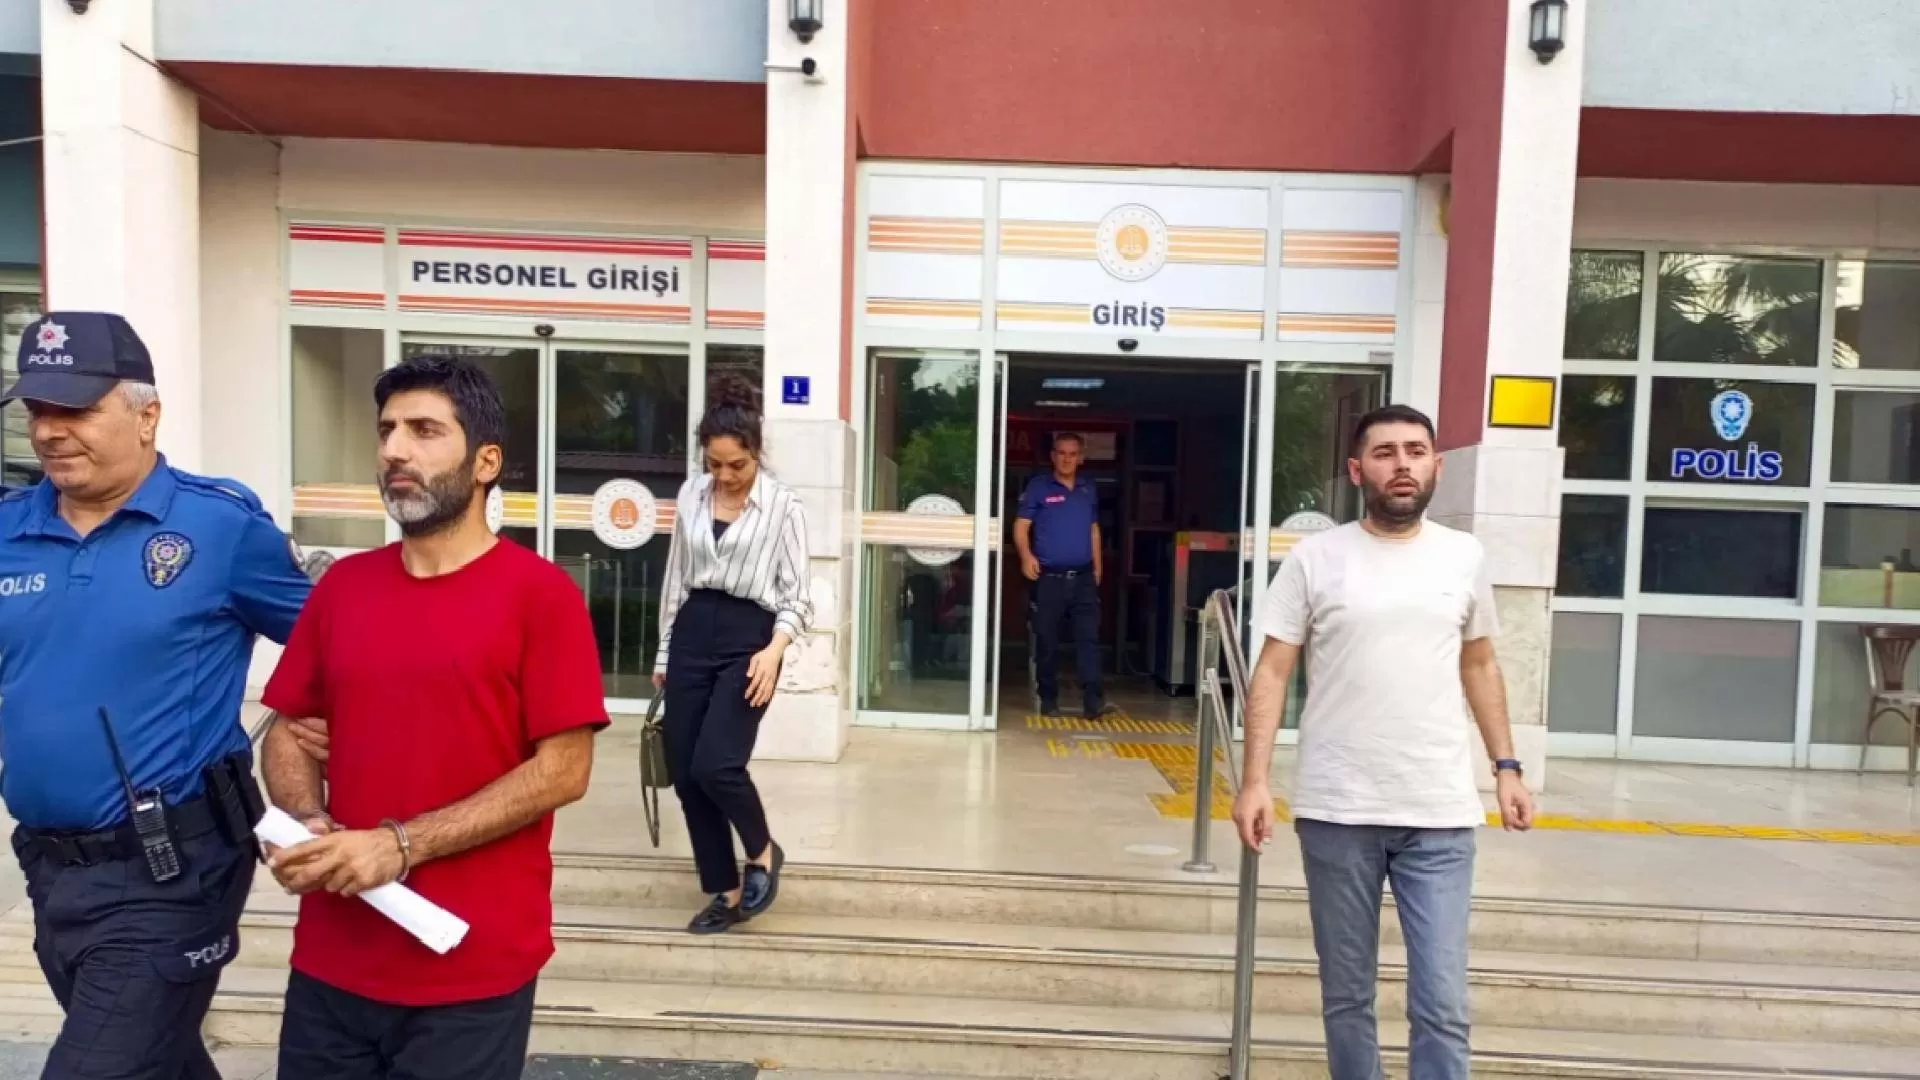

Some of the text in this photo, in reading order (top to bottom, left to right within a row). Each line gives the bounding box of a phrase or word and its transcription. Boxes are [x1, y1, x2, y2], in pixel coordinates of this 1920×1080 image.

[412, 260, 679, 297] PERSONEL GİRİŞİ
[1092, 300, 1165, 332] GİRİŞ
[1671, 442, 1782, 480] POLİS
